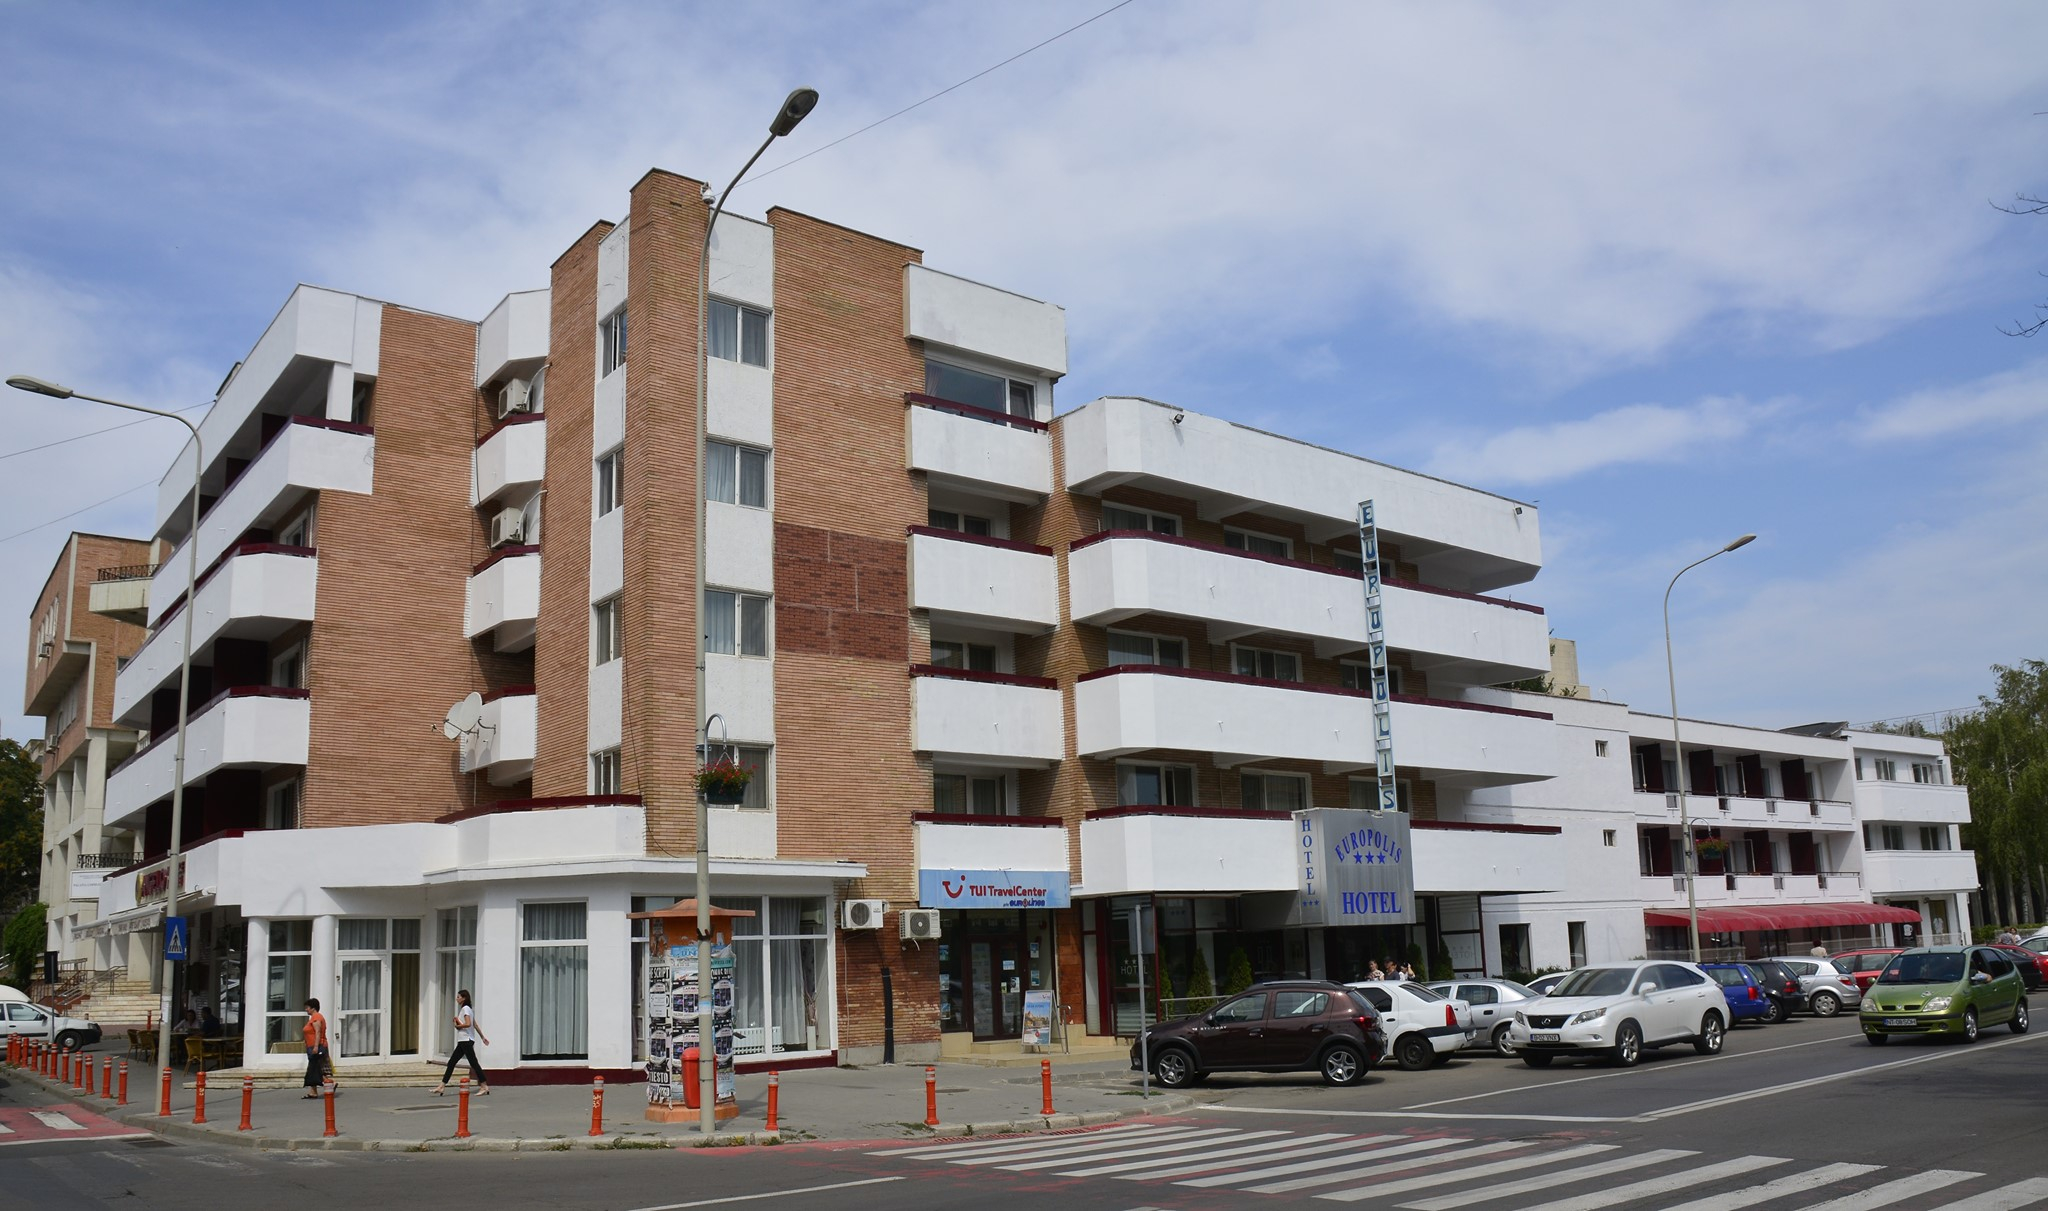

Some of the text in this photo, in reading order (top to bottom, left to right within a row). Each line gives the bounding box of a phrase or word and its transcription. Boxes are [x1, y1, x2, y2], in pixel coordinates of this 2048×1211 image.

[1362, 505, 1395, 810] EUROPOLIS
[1301, 819, 1316, 896] HOTEL
[1335, 828, 1402, 864] EUROPOLIS
[969, 885, 1047, 897] TUI TravelCenter
[1342, 891, 1402, 915] HOTEL
[1120, 965, 1148, 975] HOTL
